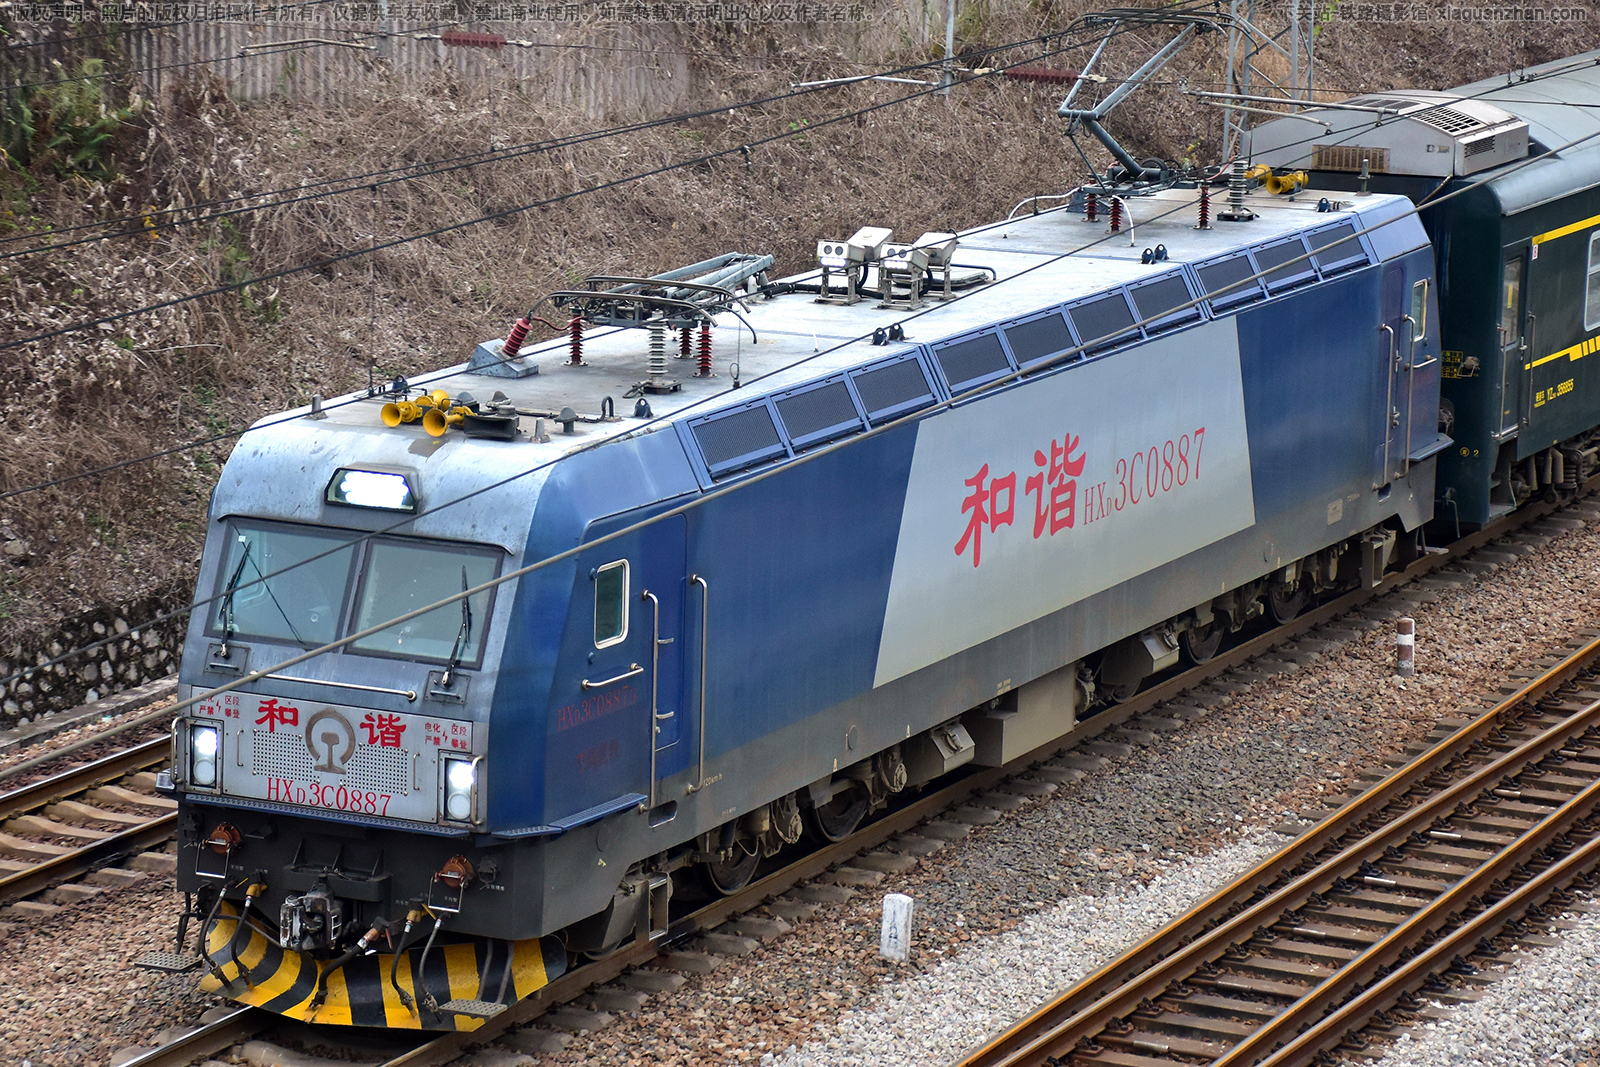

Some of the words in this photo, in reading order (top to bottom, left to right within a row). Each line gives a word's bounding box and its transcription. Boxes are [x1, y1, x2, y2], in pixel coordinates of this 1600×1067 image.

[954, 432, 1086, 568] 和谐
[225, 695, 240, 706] 区段
[255, 698, 299, 732] 和
[360, 713, 407, 748] 谐
[424, 721, 441, 733] 电化
[451, 725, 467, 736] 区段
[267, 777, 391, 816] HXD3C0887
